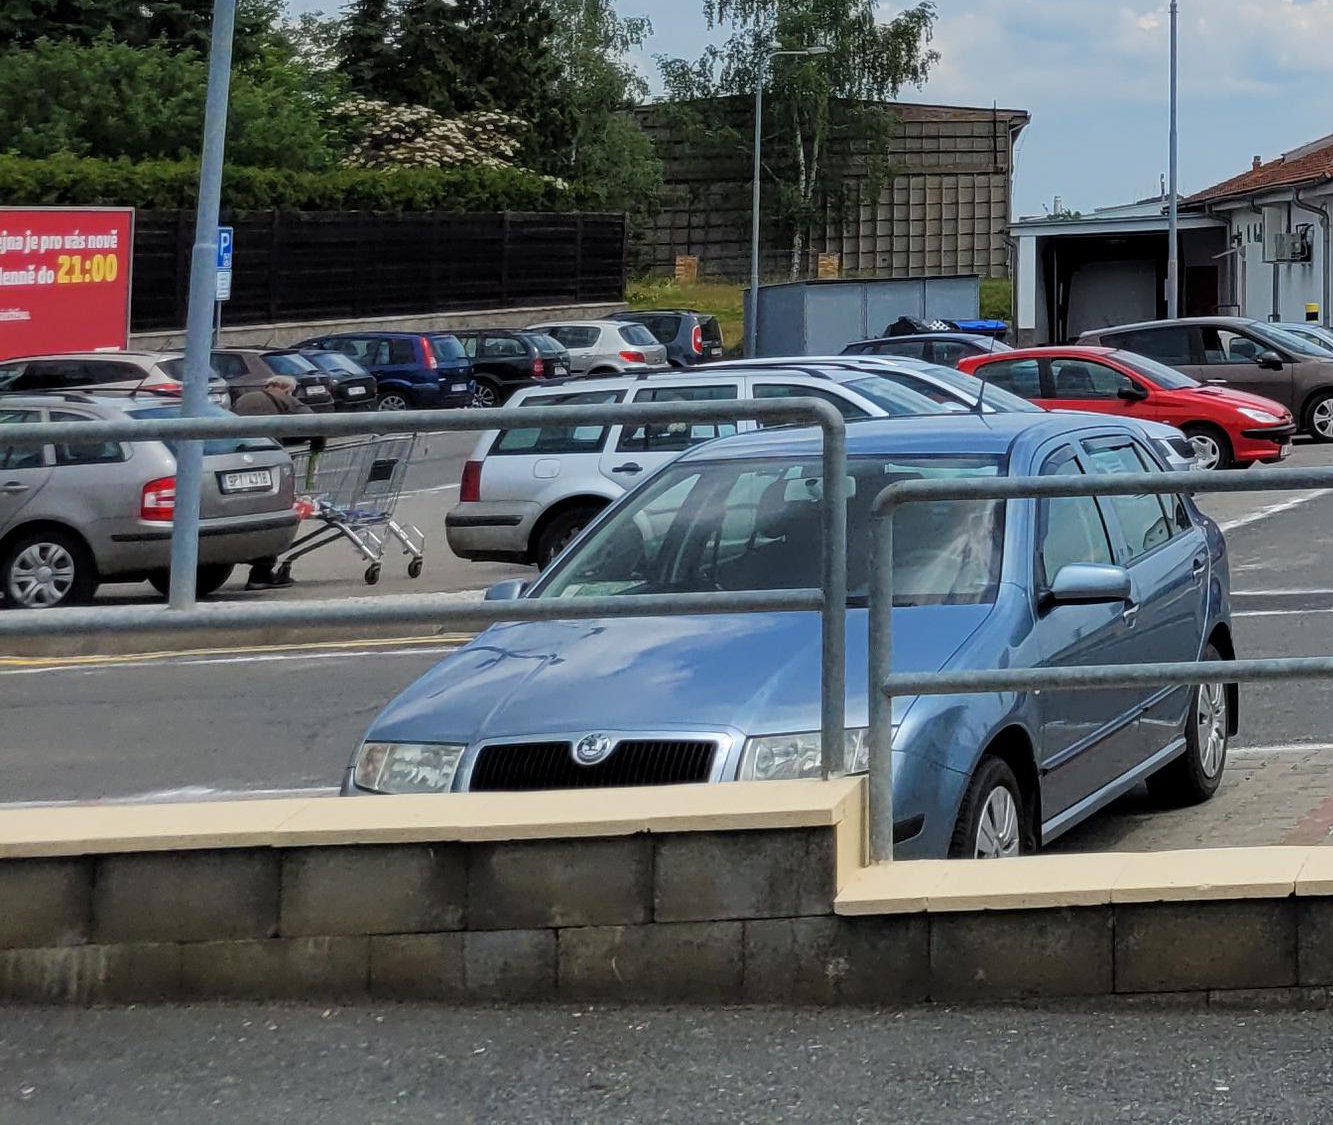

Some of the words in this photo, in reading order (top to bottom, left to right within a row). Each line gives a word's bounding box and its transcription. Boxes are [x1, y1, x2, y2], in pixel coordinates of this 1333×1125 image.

[24, 230, 38, 254] je
[40, 235, 62, 254] pro
[64, 229, 86, 249] vás
[87, 229, 118, 249] nově
[221, 233, 230, 256] P
[37, 266, 55, 284] do
[57, 254, 118, 283] 21:00
